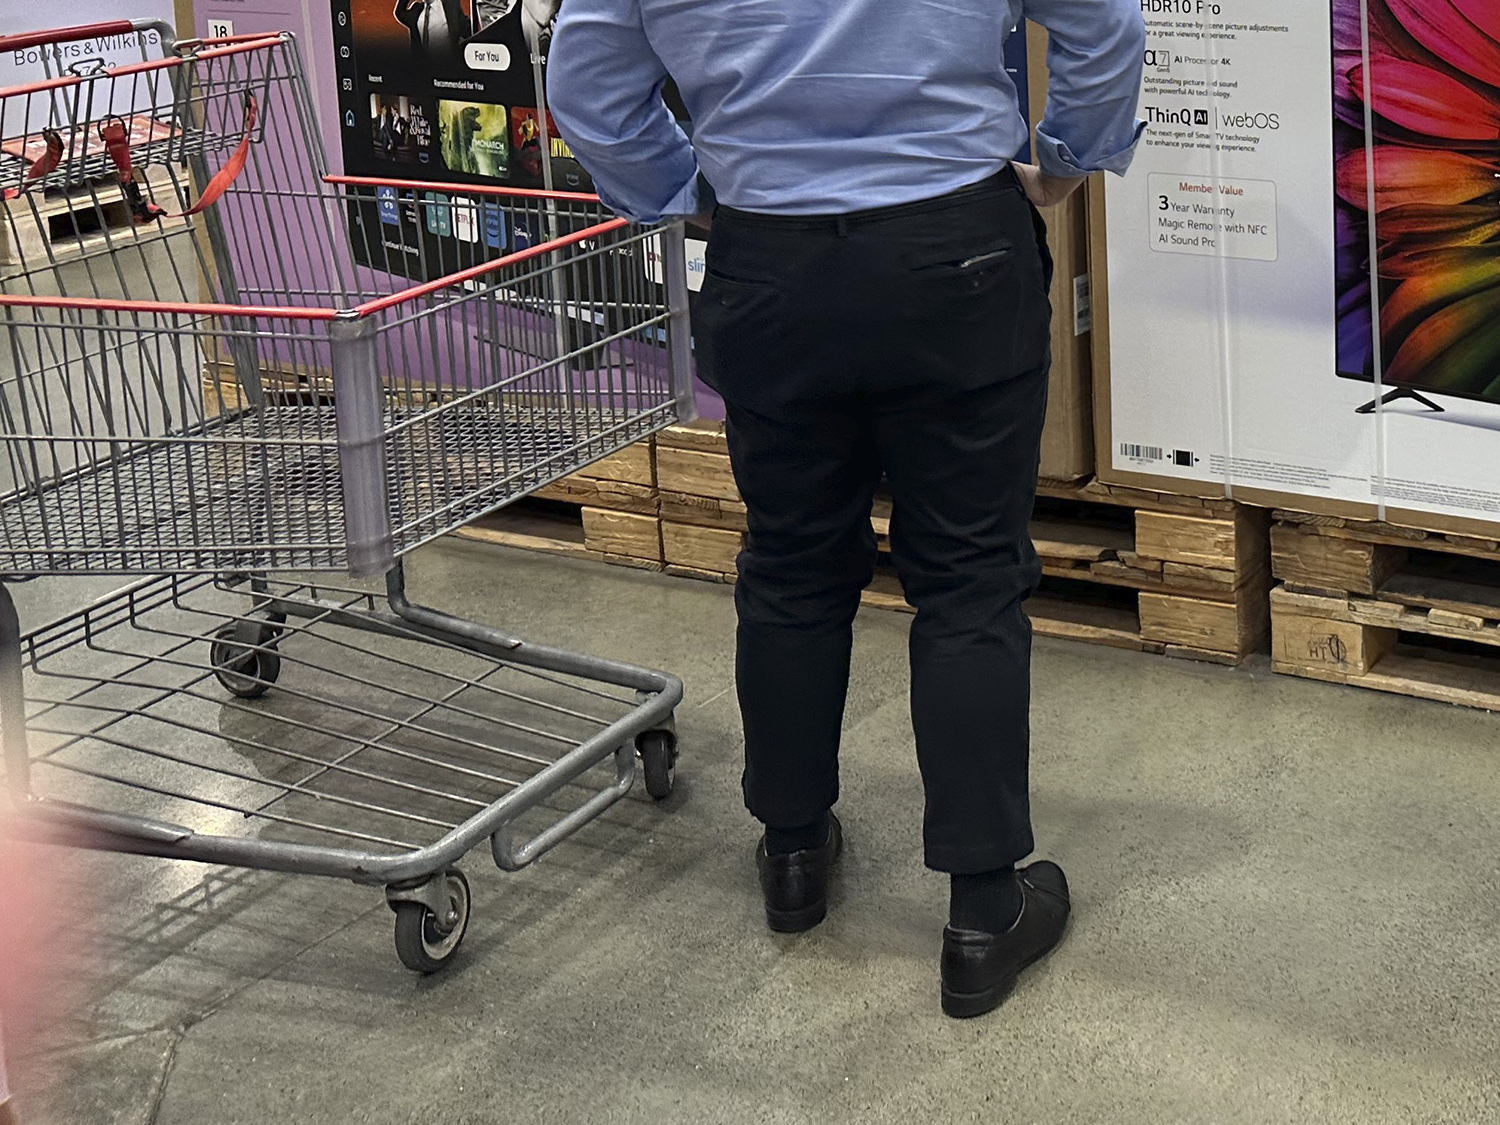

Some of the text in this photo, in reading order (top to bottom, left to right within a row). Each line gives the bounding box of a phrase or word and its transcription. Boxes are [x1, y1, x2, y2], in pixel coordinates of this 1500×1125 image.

[474, 51, 500, 63] For You
[1145, 106, 1192, 126] ThinQ
[1222, 112, 1280, 130] webOS
[1179, 181, 1244, 196] Membe Value
[1158, 194, 1235, 218] 3 Year Warnty
[1158, 217, 1268, 236] Magic Remoe with NFC
